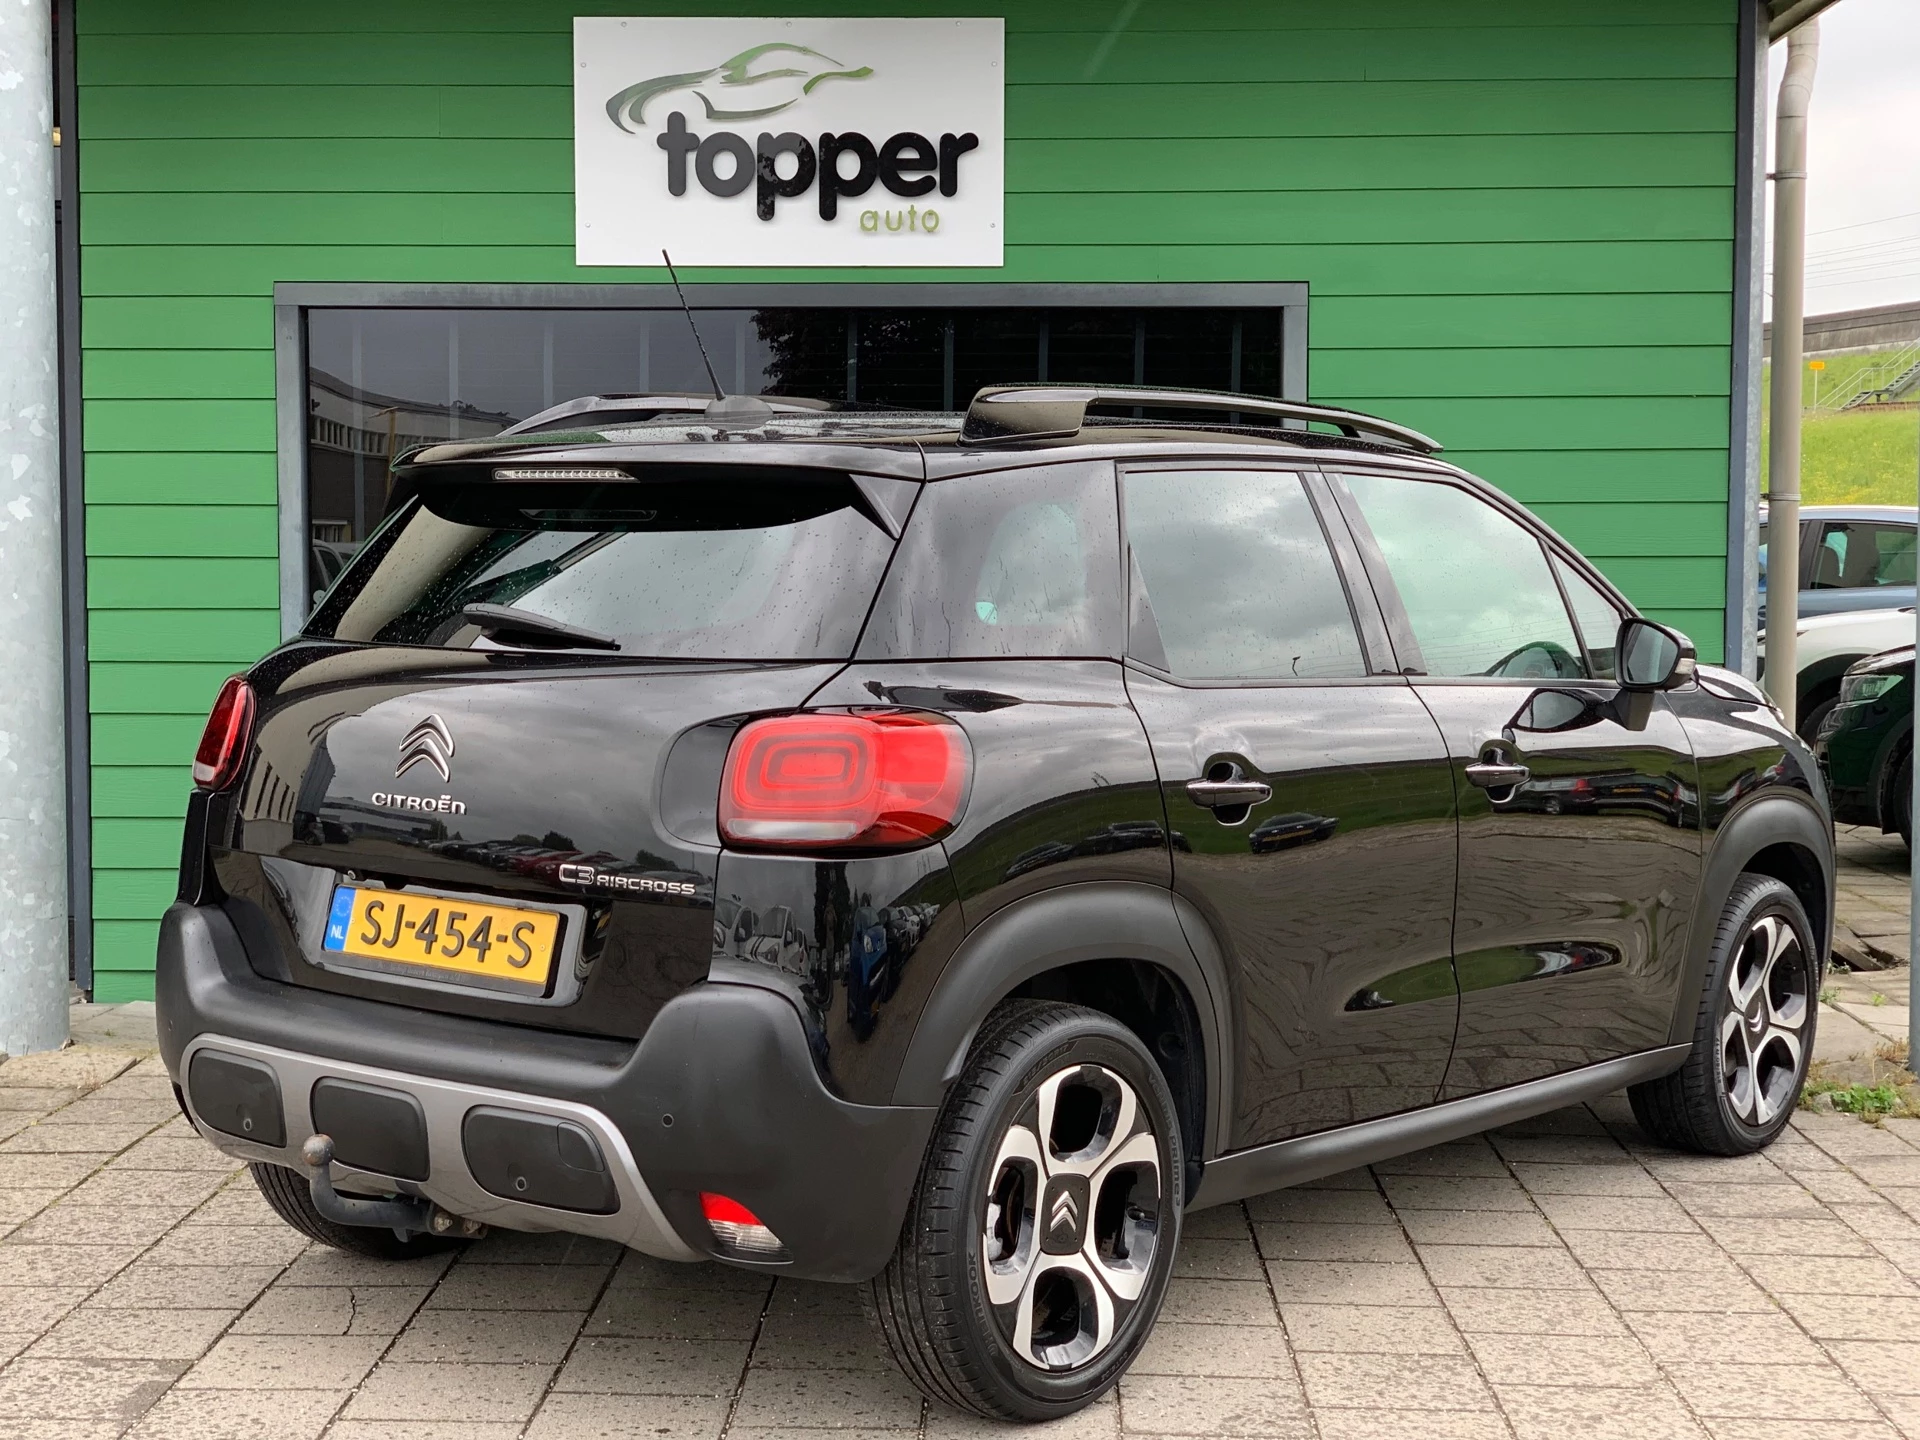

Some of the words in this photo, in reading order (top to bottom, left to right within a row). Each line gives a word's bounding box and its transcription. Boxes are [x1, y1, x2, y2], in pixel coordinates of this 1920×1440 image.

[656, 111, 980, 222] topper
[859, 204, 941, 233] auto
[371, 792, 467, 815] CITROËN
[558, 863, 595, 885] C3
[596, 874, 697, 896] AIRCROSS
[330, 924, 345, 940] NL
[360, 900, 536, 969] SJ-454-S
